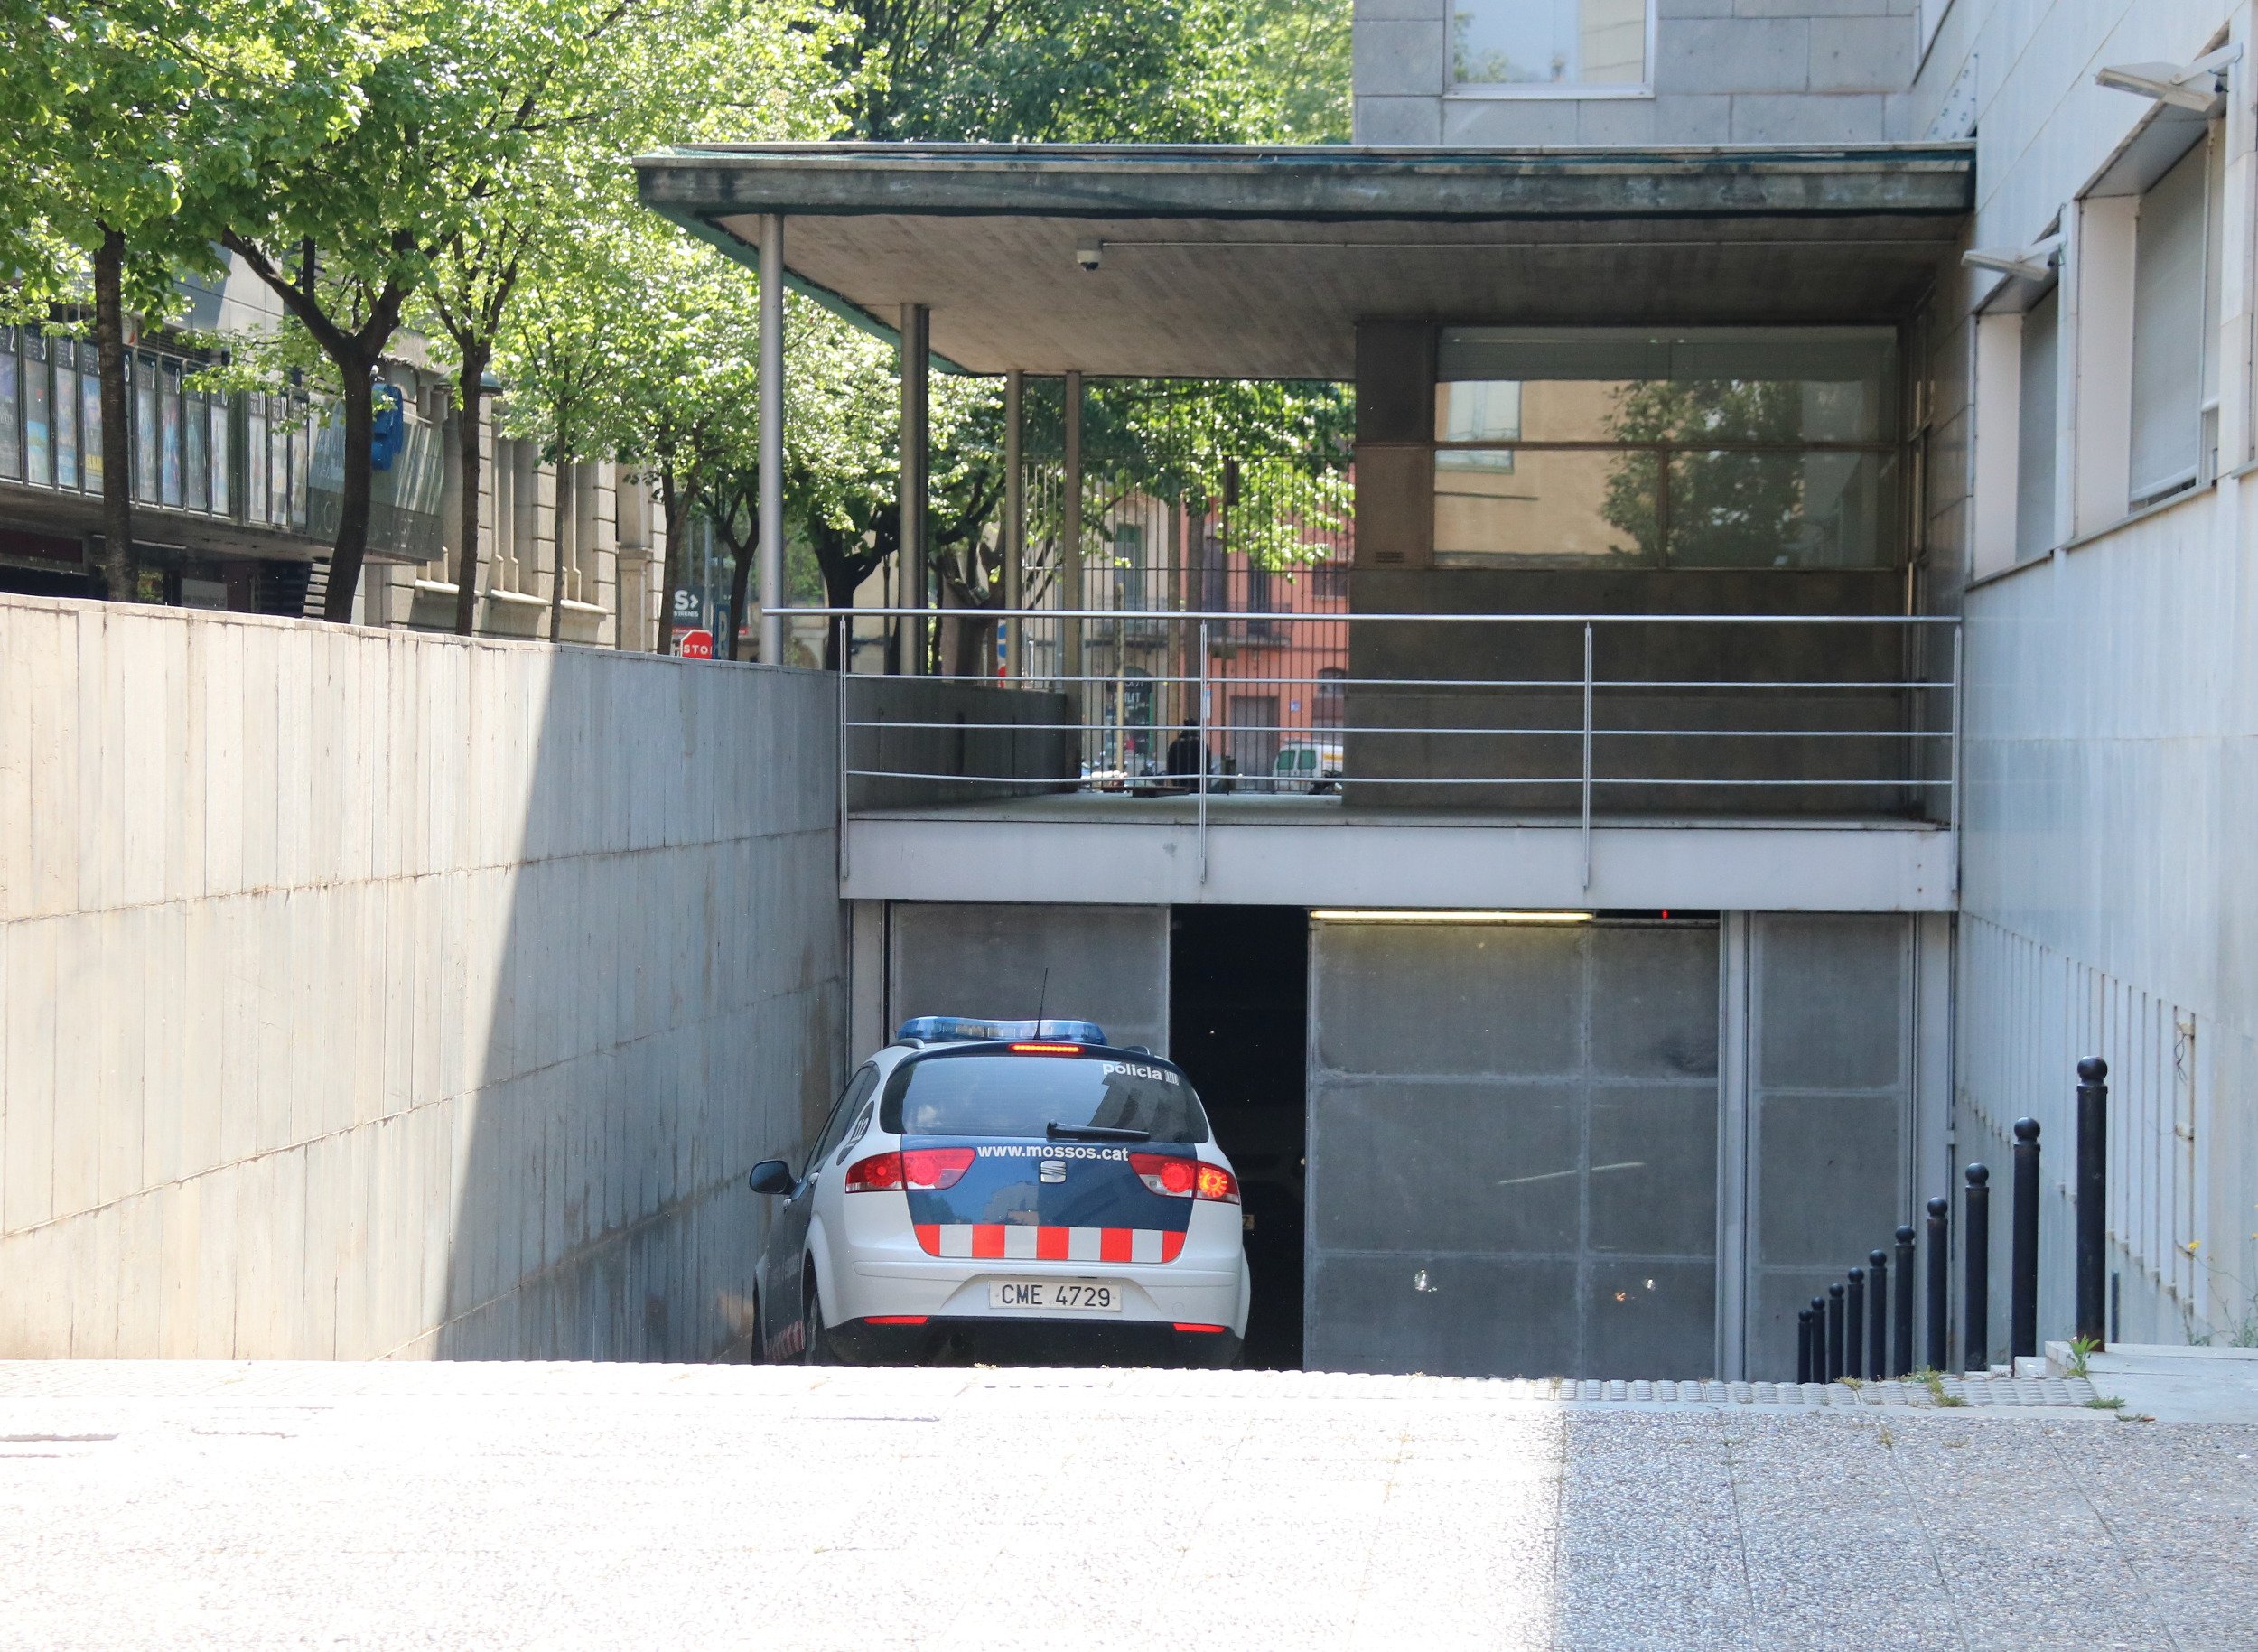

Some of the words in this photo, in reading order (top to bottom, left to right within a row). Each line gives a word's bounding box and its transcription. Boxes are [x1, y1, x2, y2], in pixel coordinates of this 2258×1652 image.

[124, 355, 130, 382] 6
[151, 361, 155, 388] 7
[175, 368, 181, 394] 8
[683, 644, 712, 655] STO
[1102, 1063, 1162, 1080] policia
[850, 1117, 870, 1142] 112
[977, 1145, 1129, 1162] www.mossos.cat
[1002, 1284, 1042, 1305] CME
[1055, 1285, 1111, 1307] 4729
